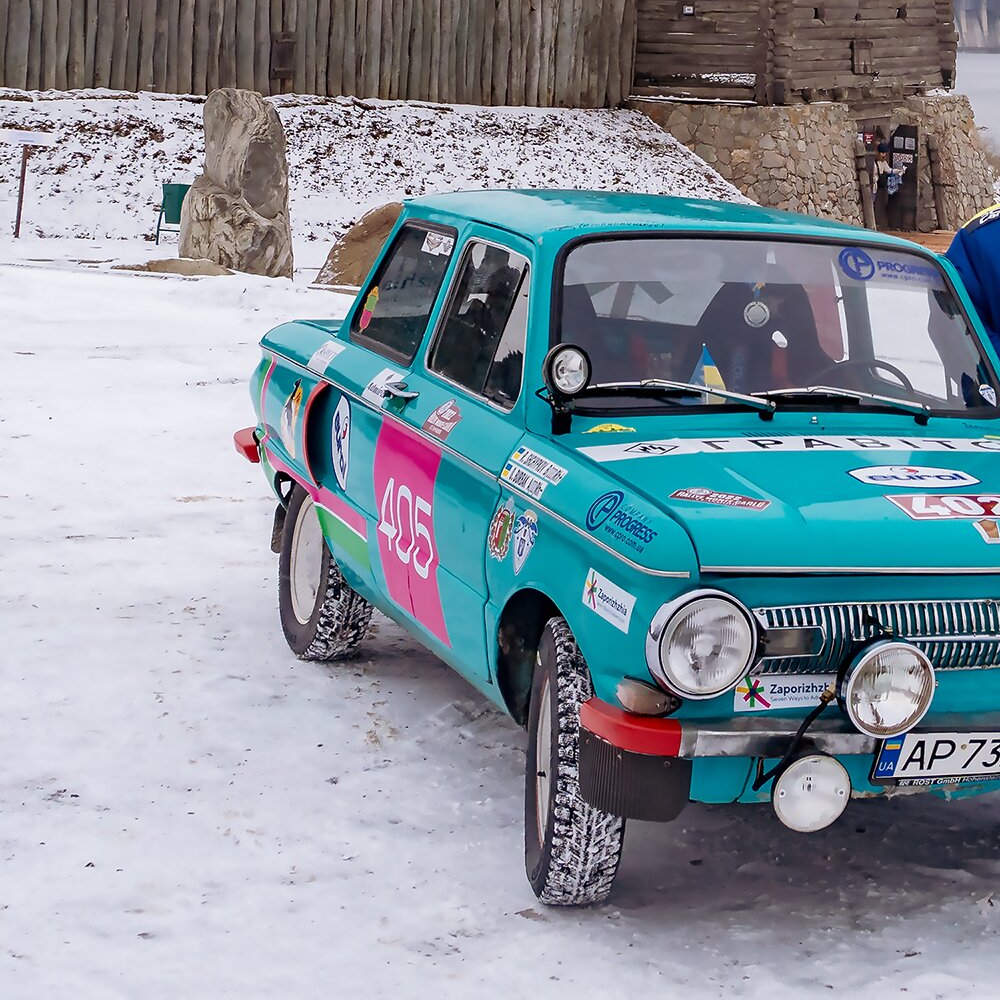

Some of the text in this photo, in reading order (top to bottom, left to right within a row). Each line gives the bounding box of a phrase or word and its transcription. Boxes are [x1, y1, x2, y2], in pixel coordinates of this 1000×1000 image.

[868, 472, 969, 482] eurol
[378, 477, 434, 579] 405
[604, 525, 645, 554] www.cpro.com.ua
[609, 511, 658, 543] PROGRESS
[597, 588, 628, 616] Zaporizhzhia
[878, 761, 894, 772] UA
[901, 739, 956, 771] AP
[936, 777, 962, 785] GmbH
